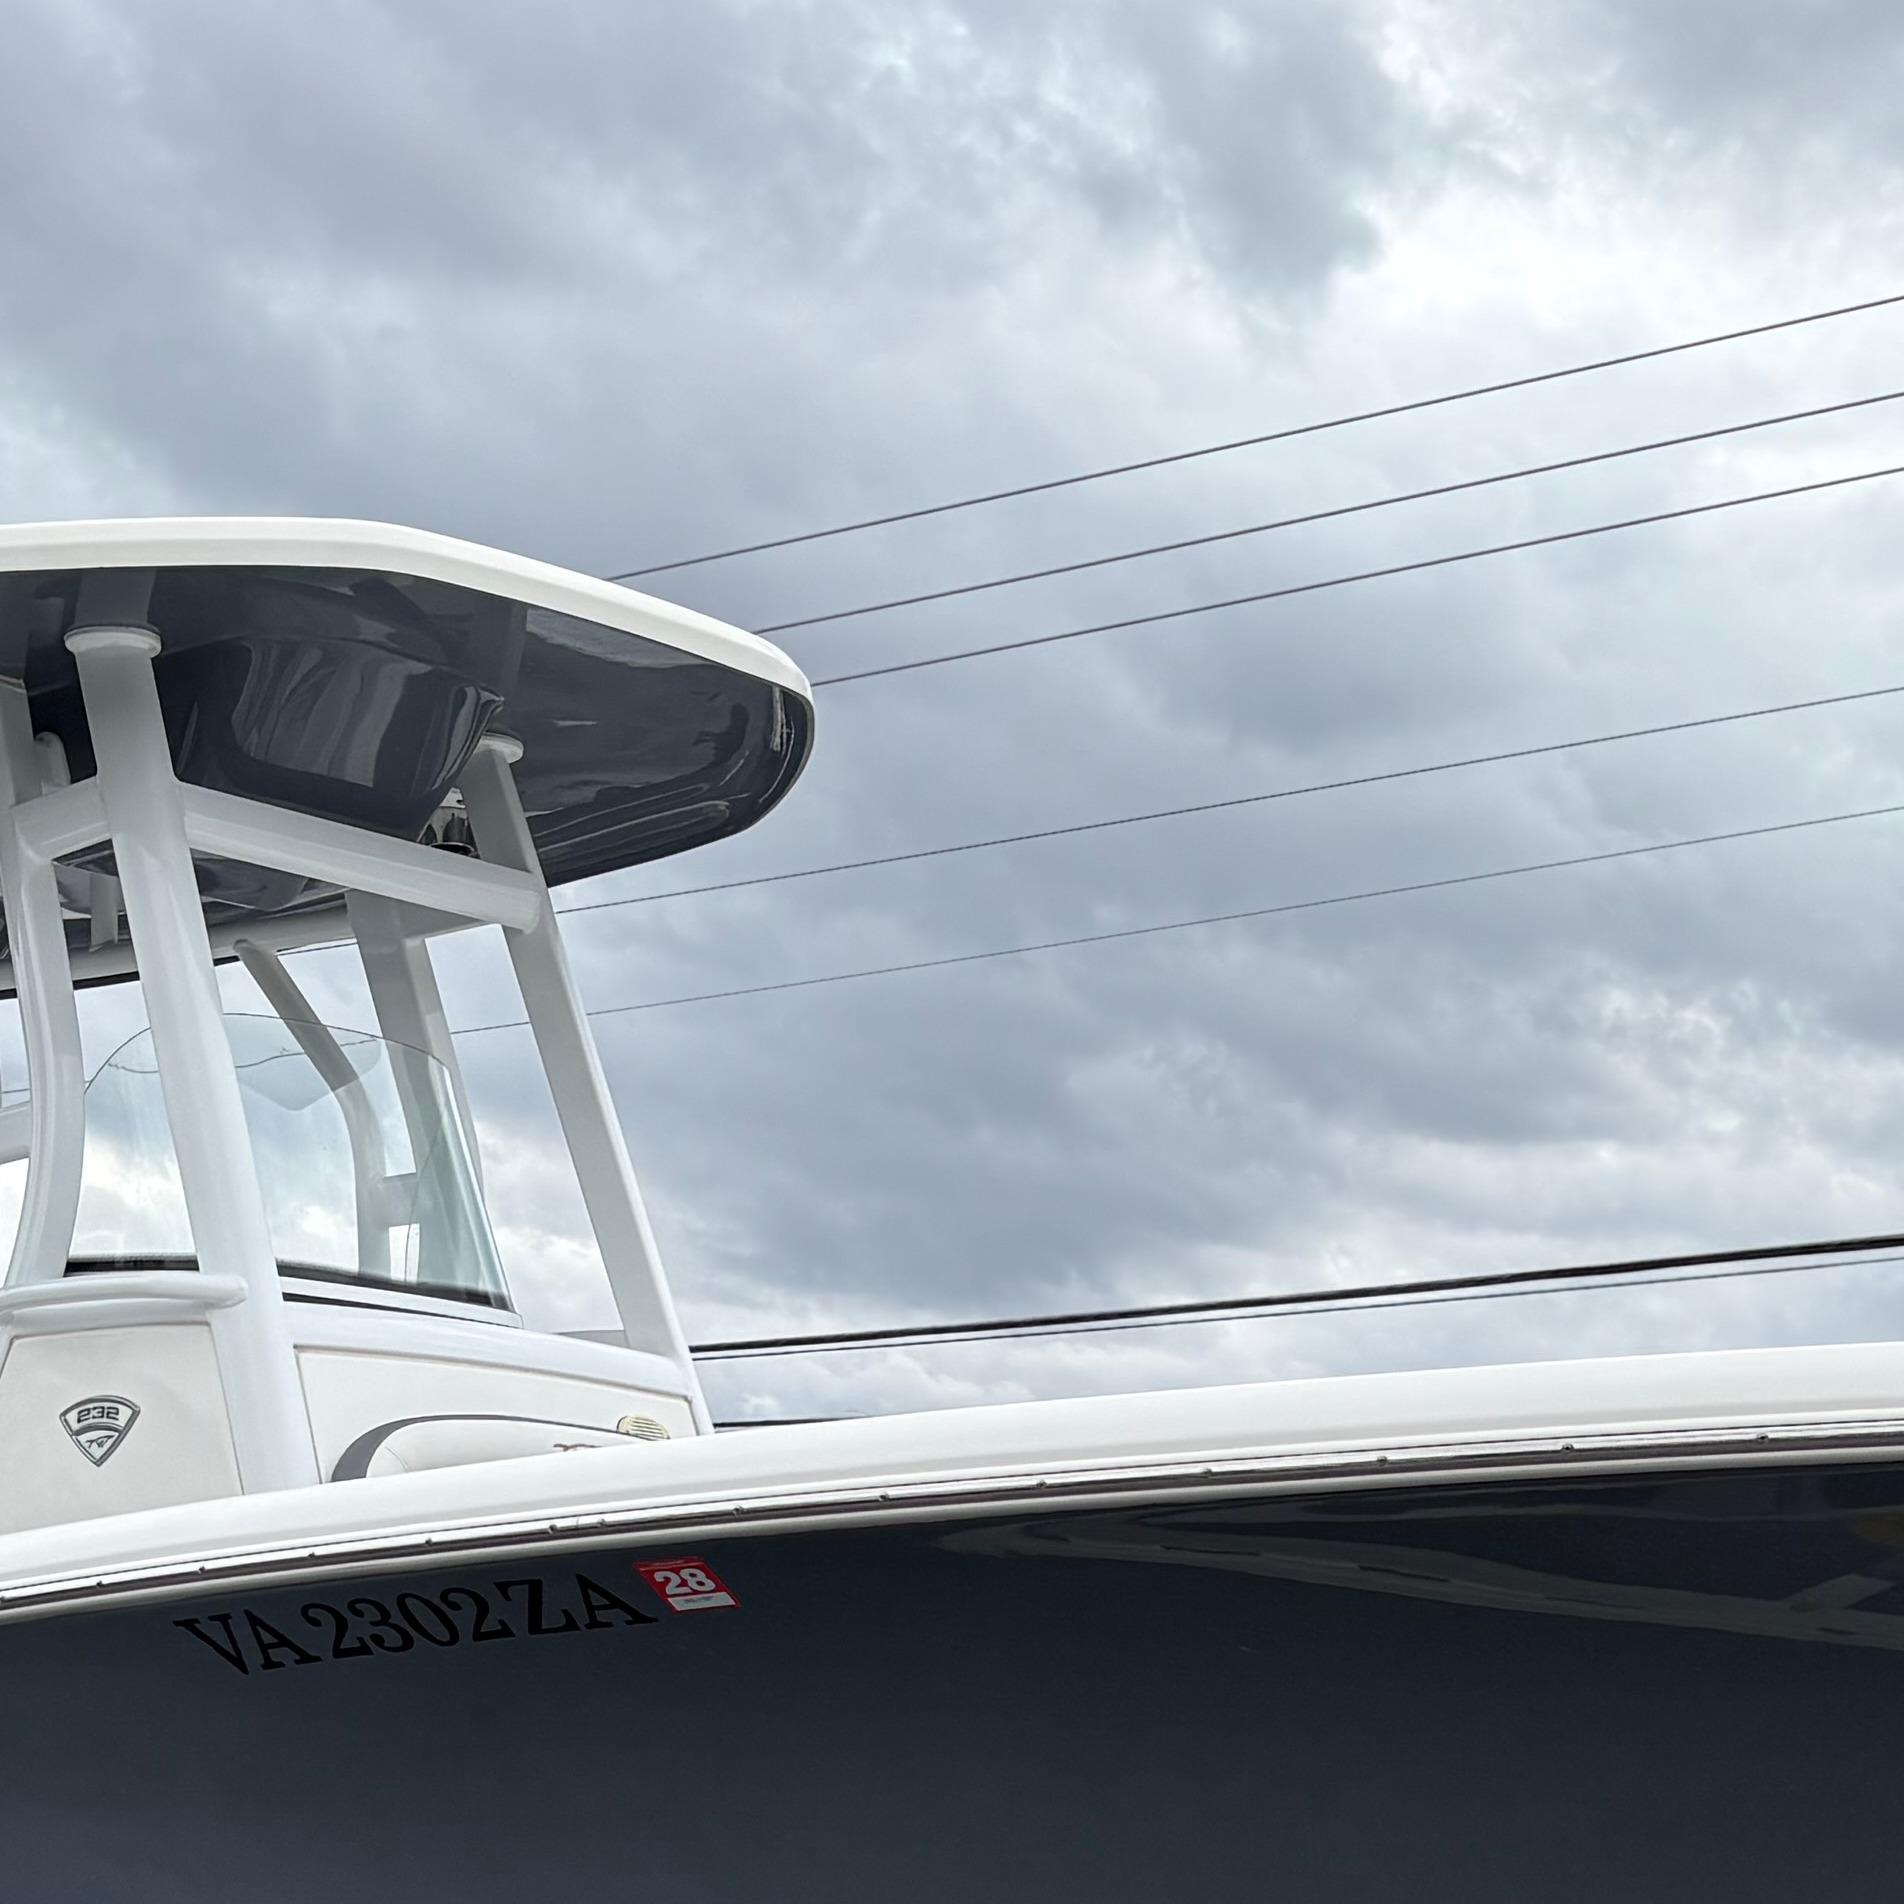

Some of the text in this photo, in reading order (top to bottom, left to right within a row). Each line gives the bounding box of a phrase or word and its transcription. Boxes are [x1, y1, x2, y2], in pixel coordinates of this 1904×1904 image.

[77, 1406, 120, 1424] 232
[654, 1568, 716, 1595] 28
[172, 1574, 659, 1675] VA 2302 ZA
